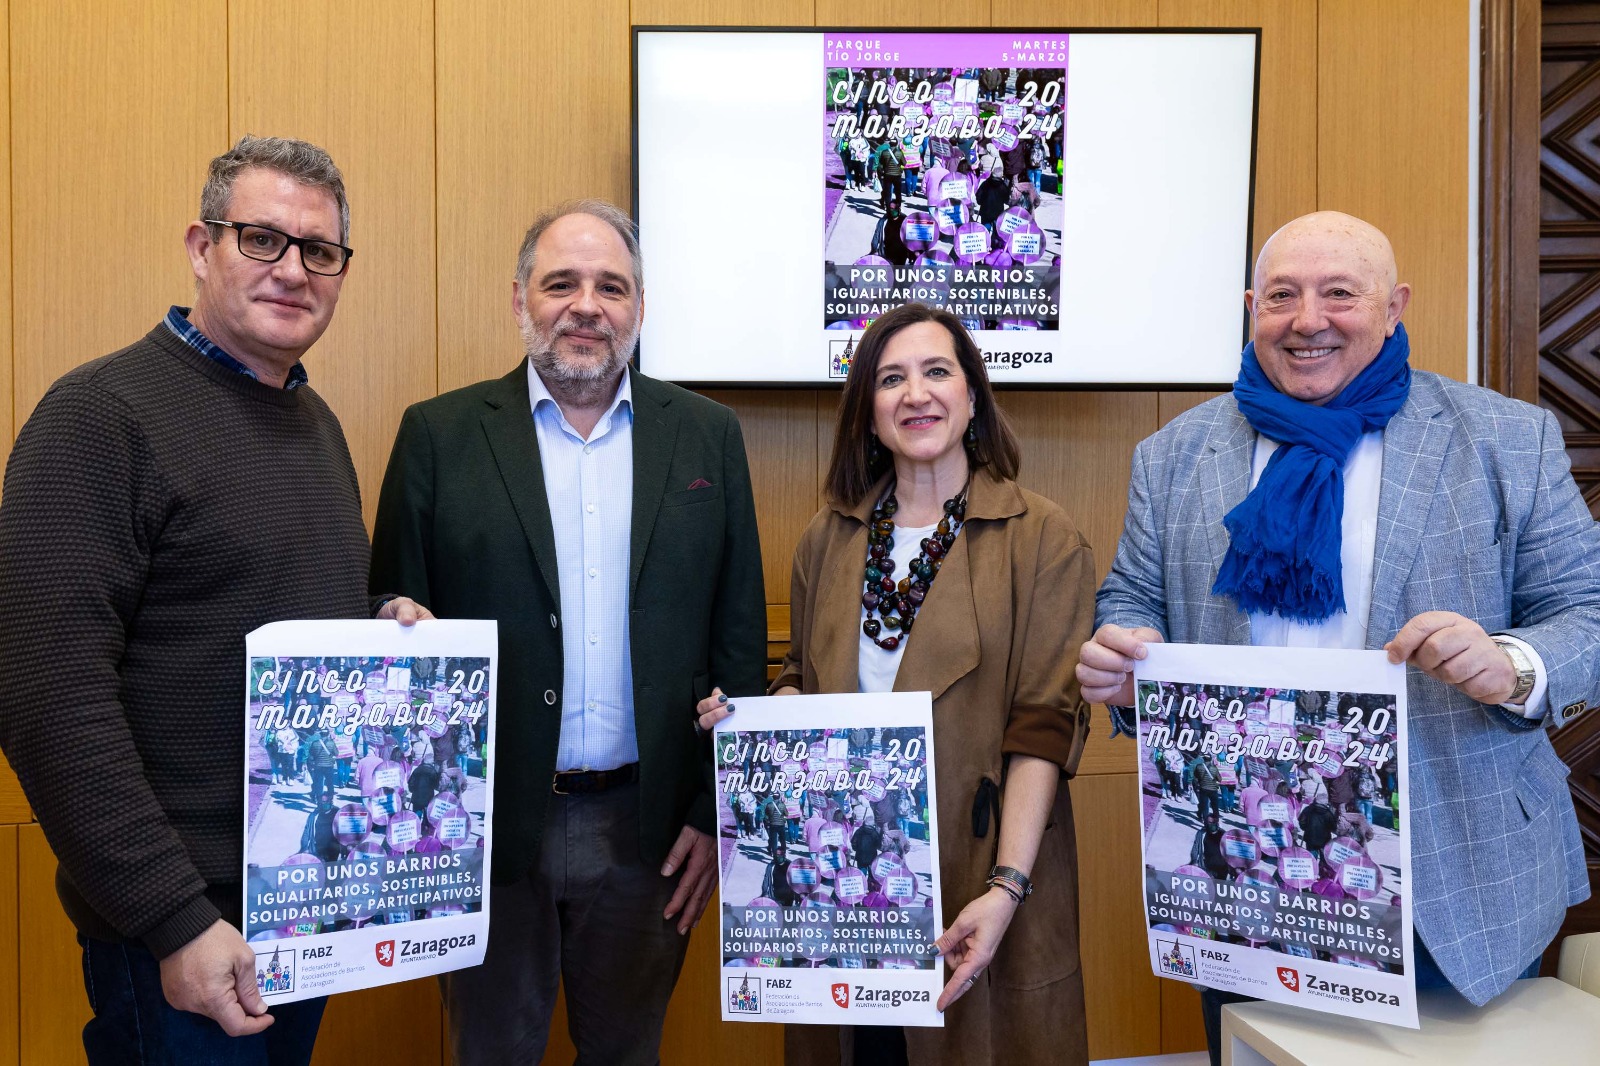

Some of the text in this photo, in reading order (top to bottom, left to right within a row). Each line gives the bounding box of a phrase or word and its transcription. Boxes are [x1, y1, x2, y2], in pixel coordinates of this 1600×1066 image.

[827, 40, 881, 50] PARQUE
[827, 50, 900, 62] TÍO JORGE
[1012, 41, 1066, 50] MARTES
[1002, 52, 1066, 62] 5-MARZO
[1018, 81, 1061, 107] 20
[1018, 113, 1060, 140] 24
[850, 268, 1035, 284] POR UNOS BARRIOS
[833, 287, 1052, 302] IGUALITARIOS, SOSTENIBLES,
[978, 349, 1053, 368] aragoza
[447, 669, 486, 694] 20
[446, 700, 484, 725] 24
[1341, 707, 1390, 735] 20
[884, 738, 921, 762] 20
[1342, 741, 1390, 770] 24
[885, 767, 921, 791] 24
[277, 853, 461, 885] POR UNOS BARRIOS
[257, 871, 476, 906] IGUALITARIOS, SOSTENIBLES,
[1171, 876, 1371, 920] POR UNOS BARRIOS
[249, 901, 348, 924] SOLIDARIOS
[368, 885, 481, 910] PARTICIPATIVOS
[745, 909, 910, 923] POR UNOS BARRIOS
[1154, 892, 1392, 943] IGUALITARIOS, SOSTENIBLES,
[730, 928, 927, 940] IGUALITARIOS, SOSTENIBLES,
[1150, 906, 1240, 931] SOLIDARIOS
[1261, 926, 1402, 959] PARTICIPATIVOS
[302, 946, 333, 960] FABZ
[400, 934, 476, 956] Zaragoza
[724, 942, 804, 953] SOLIDARIOS
[1200, 949, 1231, 963] FABZ
[766, 979, 792, 989] FABZ
[1305, 973, 1401, 1006] Zaragoza
[854, 985, 930, 1007] Zaragoza
